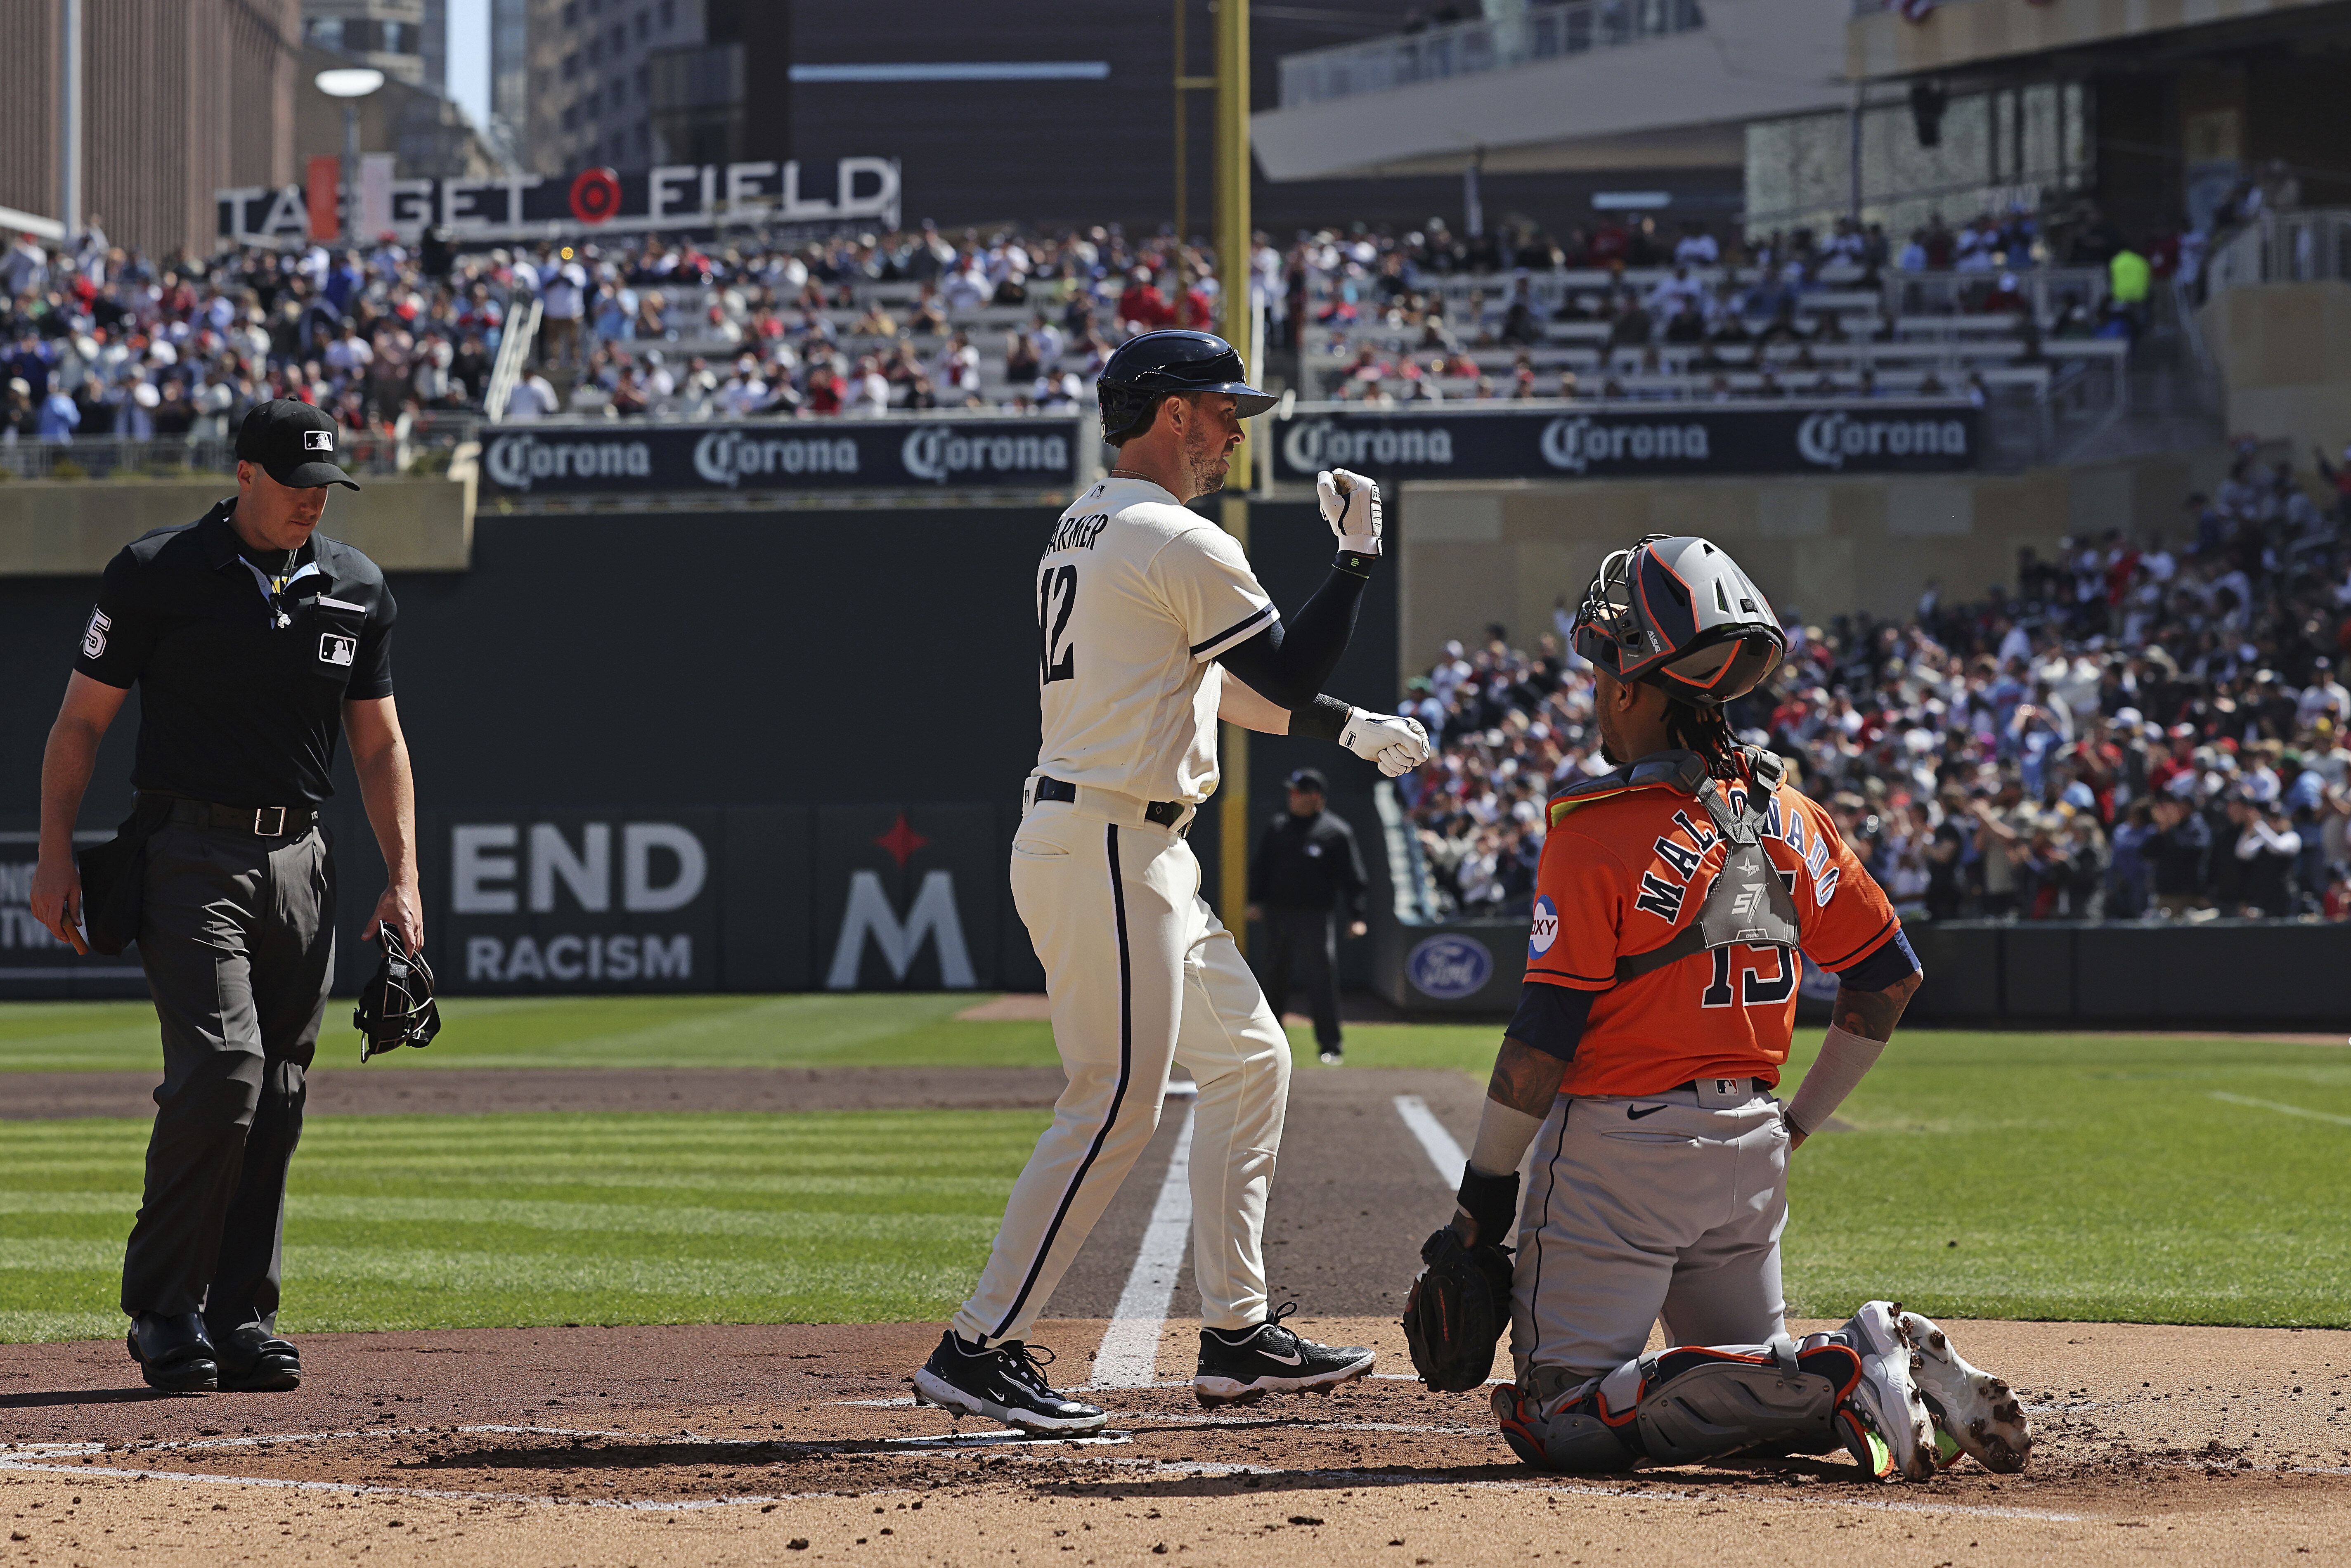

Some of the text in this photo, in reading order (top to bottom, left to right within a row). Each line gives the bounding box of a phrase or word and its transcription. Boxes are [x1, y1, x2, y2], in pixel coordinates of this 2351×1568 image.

[215, 156, 900, 244] TAGET FIELD
[486, 433, 652, 491] Corona
[693, 430, 860, 488] Corona
[902, 427, 1069, 484] Corona
[1283, 419, 1454, 473] Corona
[1539, 416, 1710, 474] Corona
[1795, 411, 1967, 469] Corona
[1042, 513, 1108, 561] ARMER
[1040, 564, 1077, 686] 12
[452, 824, 707, 913] END
[1634, 788, 1840, 926] MALONADO
[466, 933, 693, 981] RACISM
